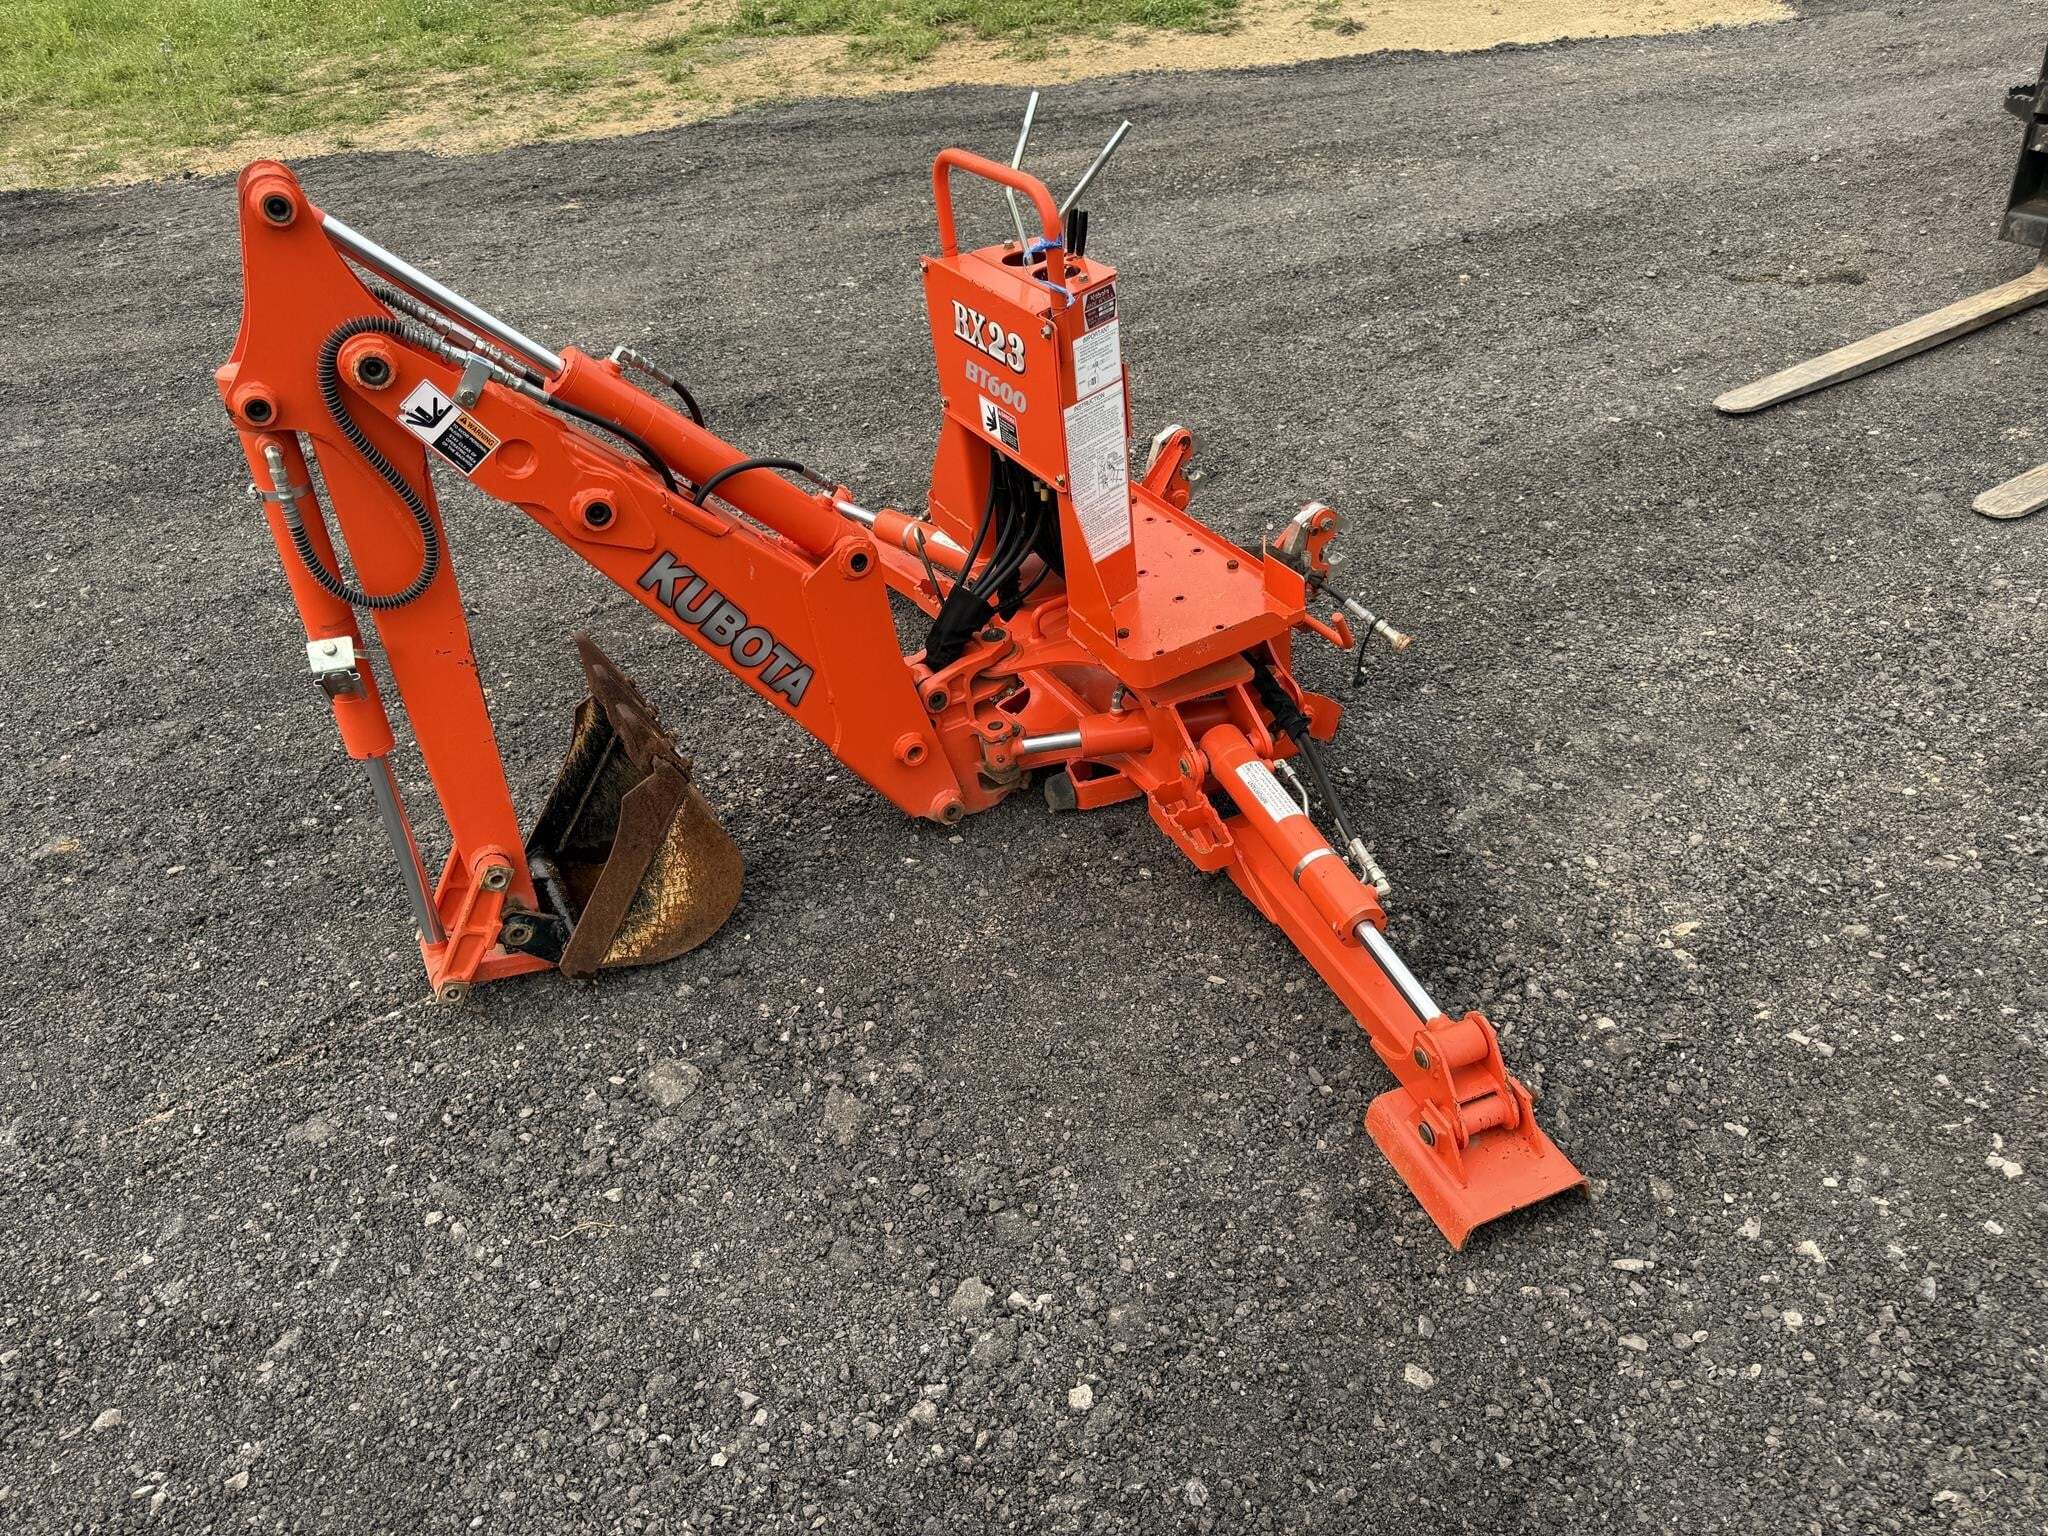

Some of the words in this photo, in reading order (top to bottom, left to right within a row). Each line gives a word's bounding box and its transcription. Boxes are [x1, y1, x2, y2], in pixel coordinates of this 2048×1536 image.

[952, 299, 1026, 375] BX23
[965, 359, 1027, 414] BT600
[466, 422, 495, 446] WARNING
[637, 550, 815, 708] KUBOTA
